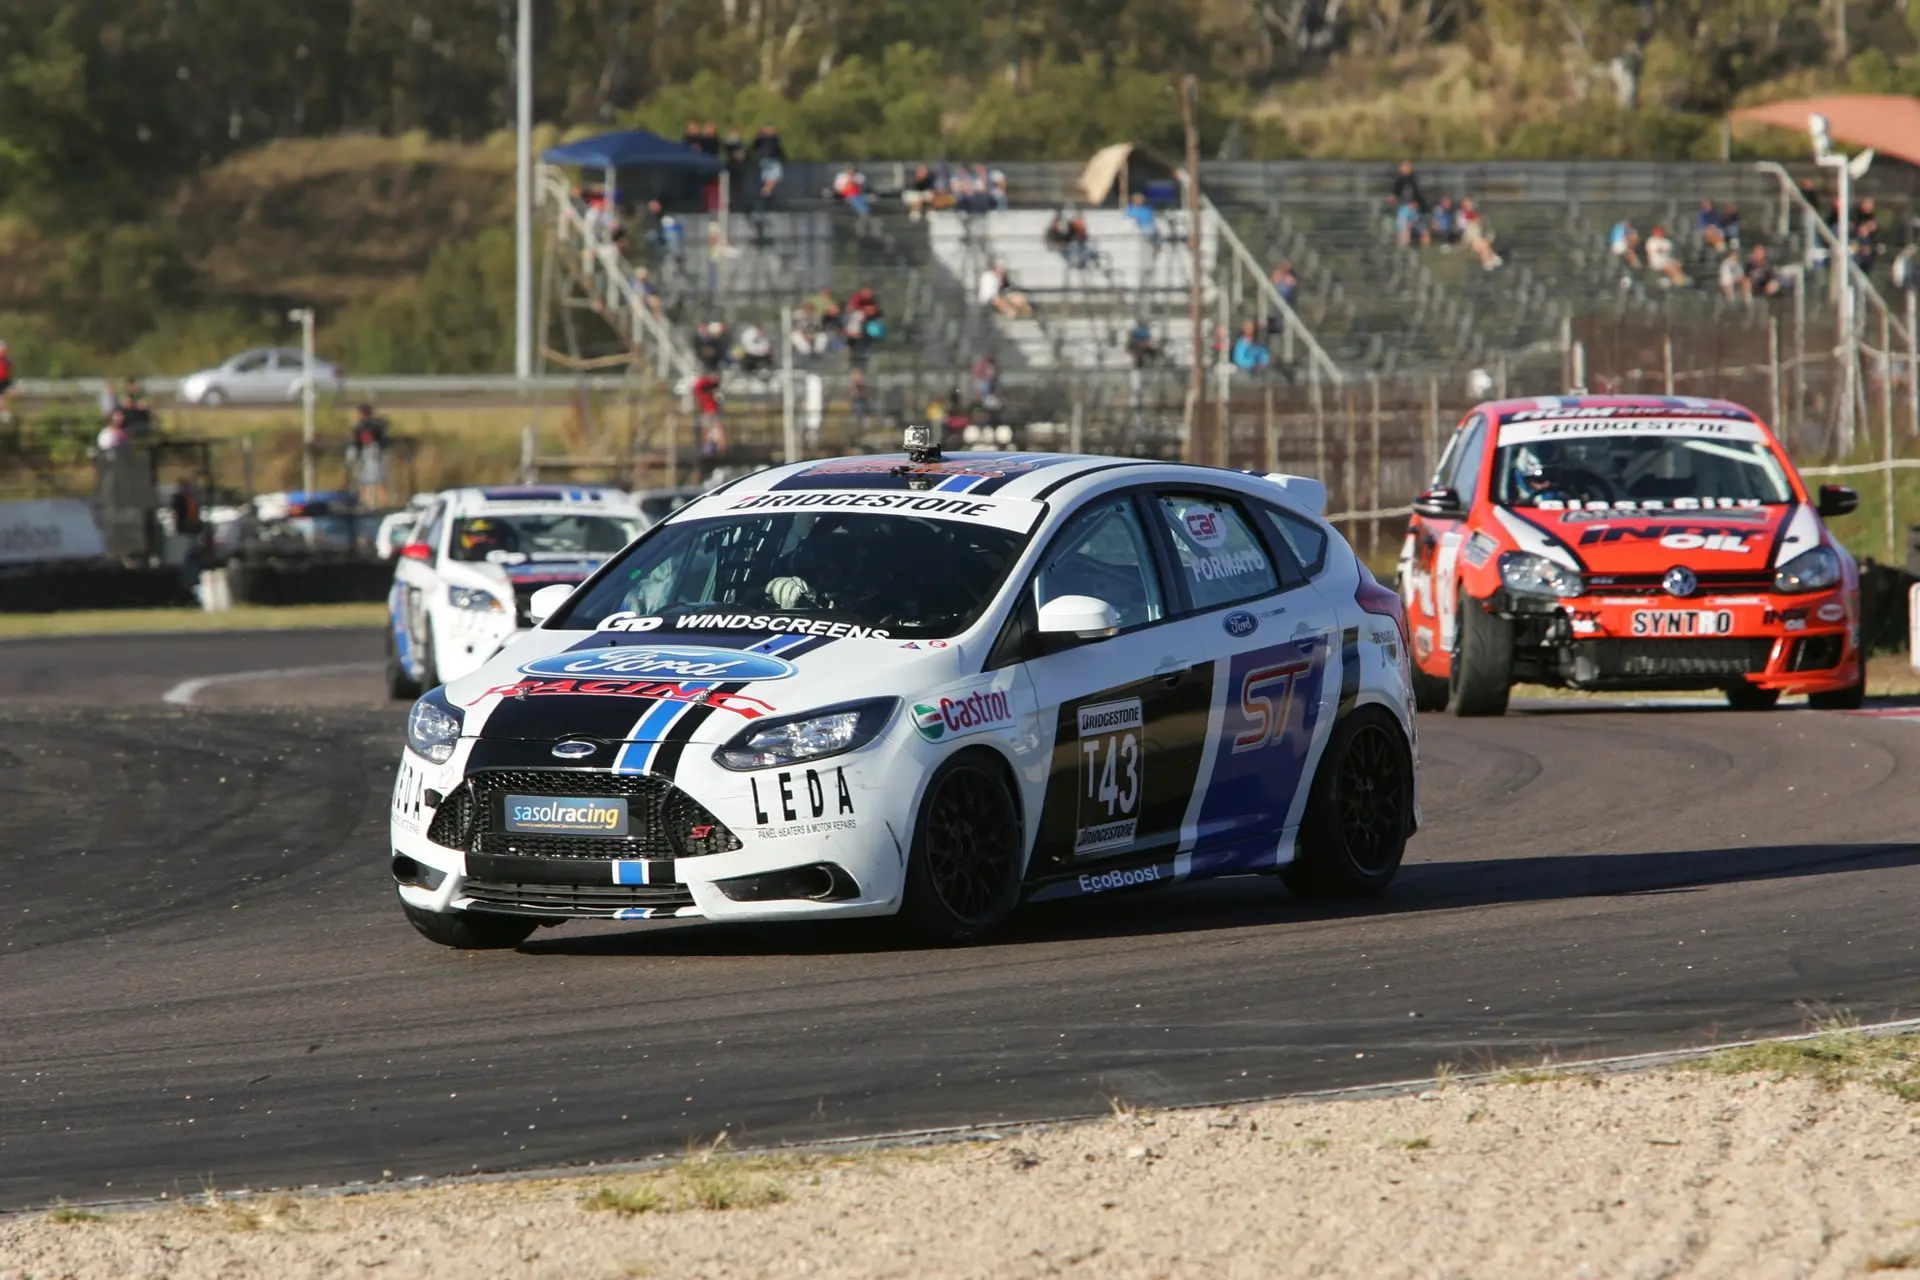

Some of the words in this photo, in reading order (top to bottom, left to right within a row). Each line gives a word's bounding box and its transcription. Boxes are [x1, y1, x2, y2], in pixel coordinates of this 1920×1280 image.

[725, 494, 997, 517] BRIDGESTONE
[1186, 512, 1217, 536] car
[1660, 533, 1751, 553] OIL
[675, 615, 890, 640] WINDSCREENS
[1229, 615, 1253, 634] Ford
[564, 650, 741, 677] Ford
[465, 680, 777, 720] RACING
[940, 686, 1012, 731] Castrol
[1232, 657, 1314, 754] ST
[1081, 706, 1140, 731] BRIDGESTONE
[1083, 733, 1139, 816] T43
[751, 766, 855, 825] LEDA
[513, 801, 619, 830] sasolracing
[811, 821, 831, 834] MOTOR
[832, 819, 857, 831] REPAIRS
[689, 825, 713, 839] ST
[1077, 821, 1135, 847] BRIDGESTONE
[1079, 863, 1161, 892] EcoBoost
